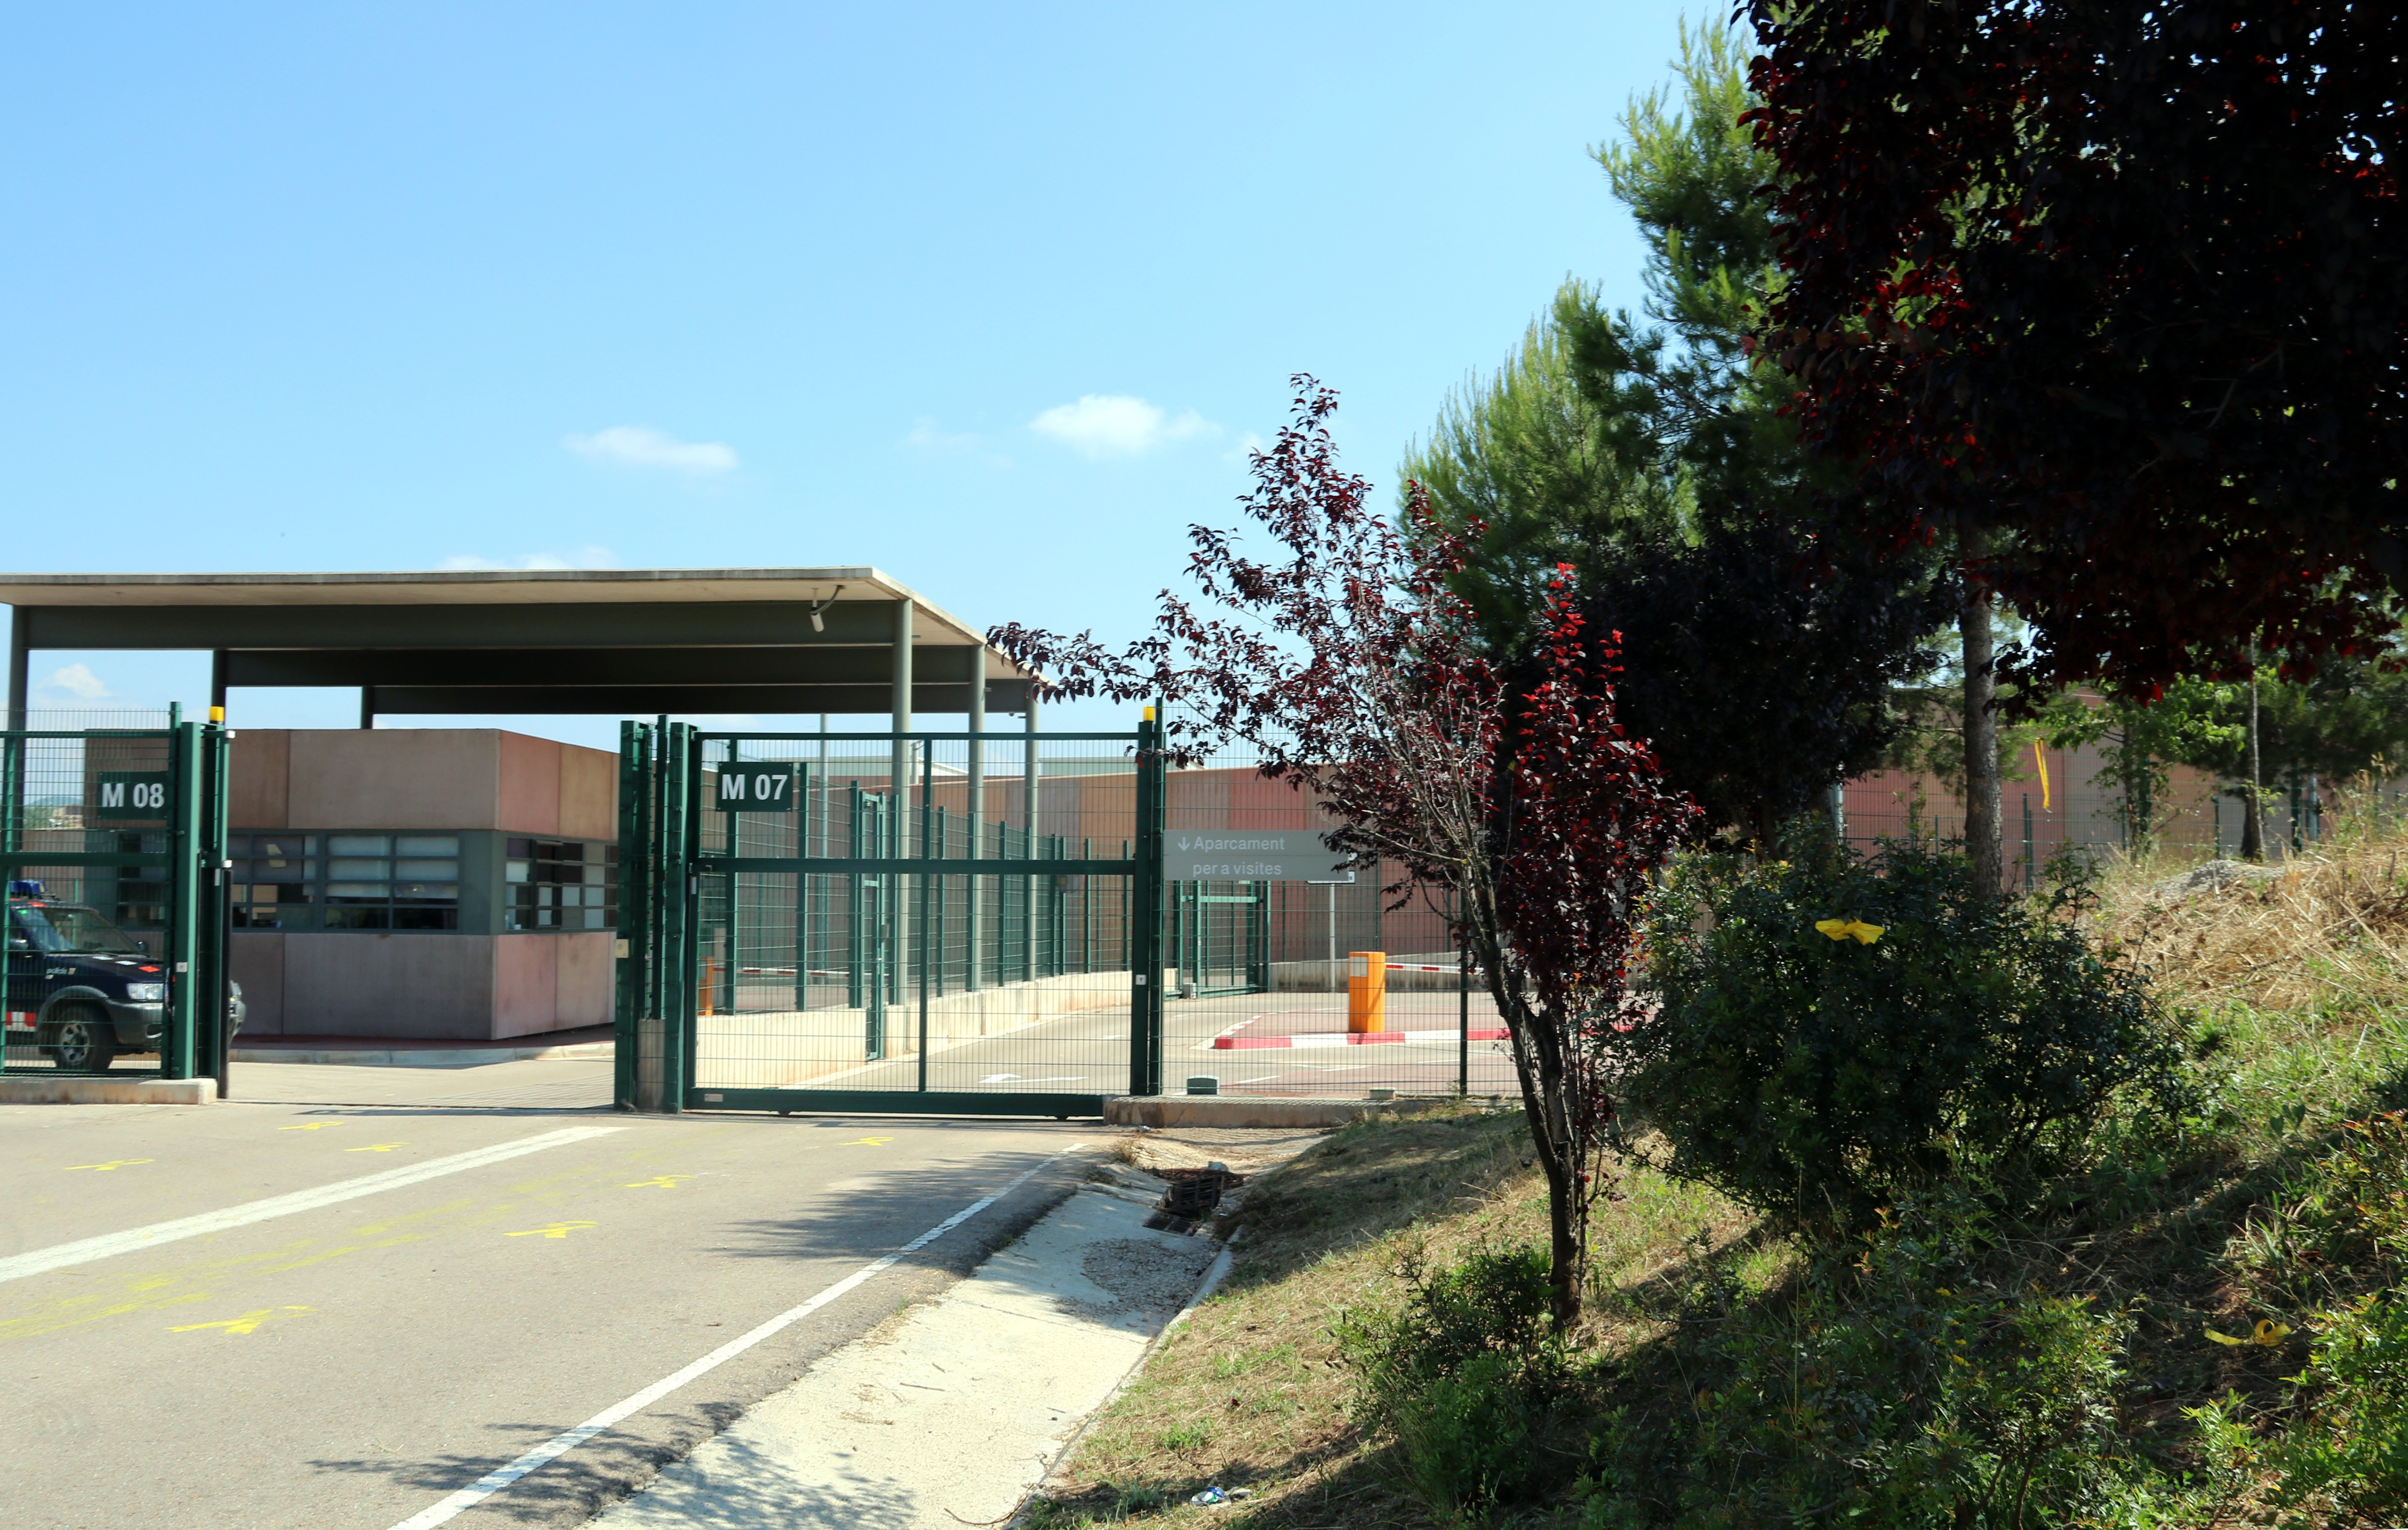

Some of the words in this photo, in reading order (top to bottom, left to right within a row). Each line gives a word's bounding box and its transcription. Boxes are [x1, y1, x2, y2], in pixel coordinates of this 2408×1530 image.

[102, 783, 124, 807] M
[133, 783, 165, 808] 08
[722, 774, 745, 800] M
[755, 774, 788, 800] 07
[1194, 836, 1285, 852] Aparcament
[1193, 864, 1218, 877] per
[1221, 864, 1230, 875] a
[1233, 861, 1282, 875] visites
